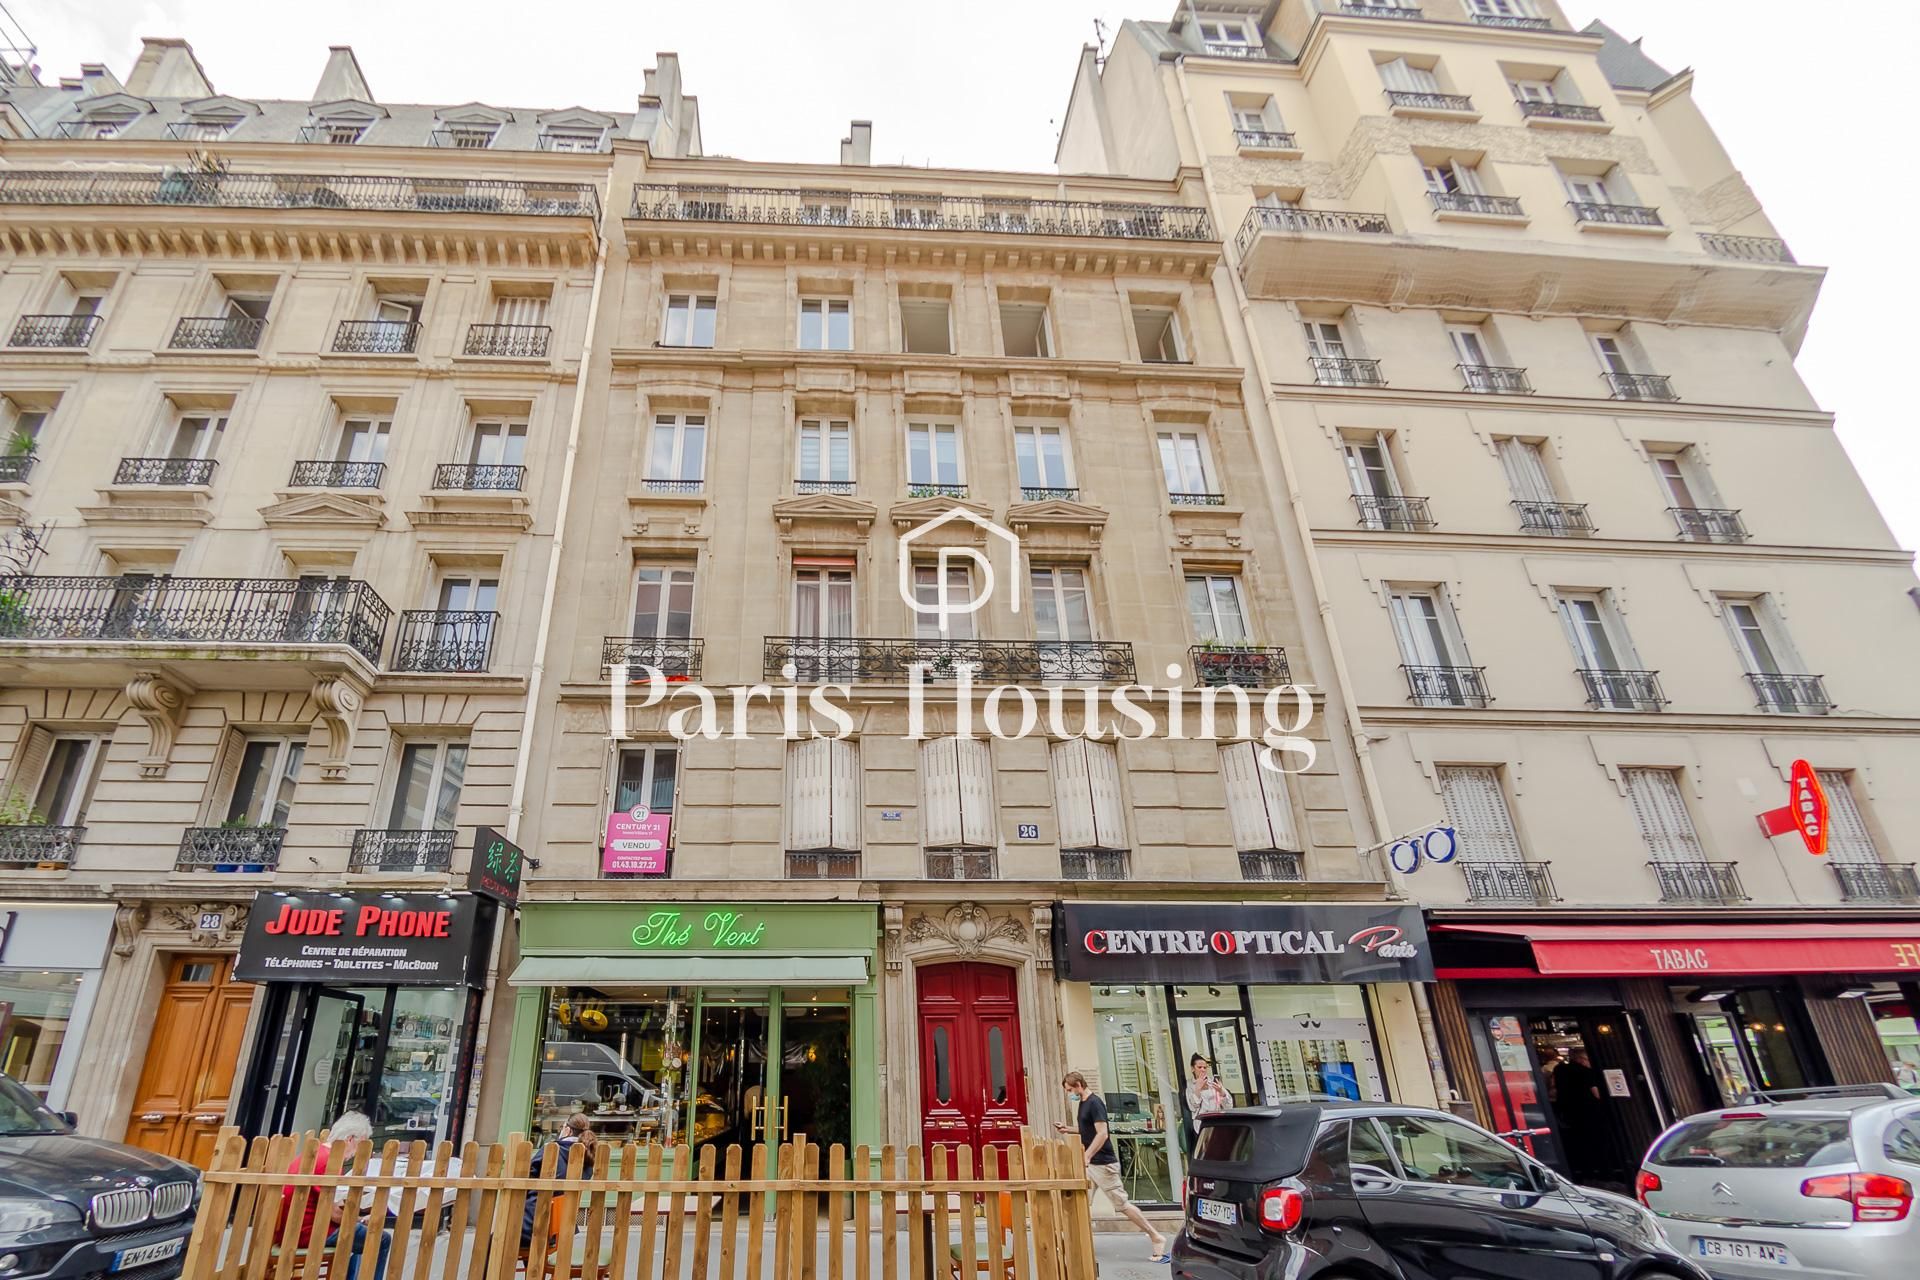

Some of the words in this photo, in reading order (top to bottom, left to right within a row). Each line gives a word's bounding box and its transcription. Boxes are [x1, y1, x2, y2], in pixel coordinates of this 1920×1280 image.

[1797, 777, 1820, 836] TABAC
[616, 823, 652, 831] CENTURY
[1020, 825, 1037, 838] 26
[201, 915, 220, 928] 28
[264, 903, 345, 936] JUDE
[356, 905, 452, 938] PHONE
[632, 912, 692, 945] Thé
[703, 912, 765, 946] Vert
[302, 945, 338, 957] CENTRE
[1083, 929, 1209, 955] CENTRE
[1210, 929, 1345, 955] OPTICAL
[1347, 924, 1418, 958] Paris
[1650, 948, 1709, 970] TABAC
